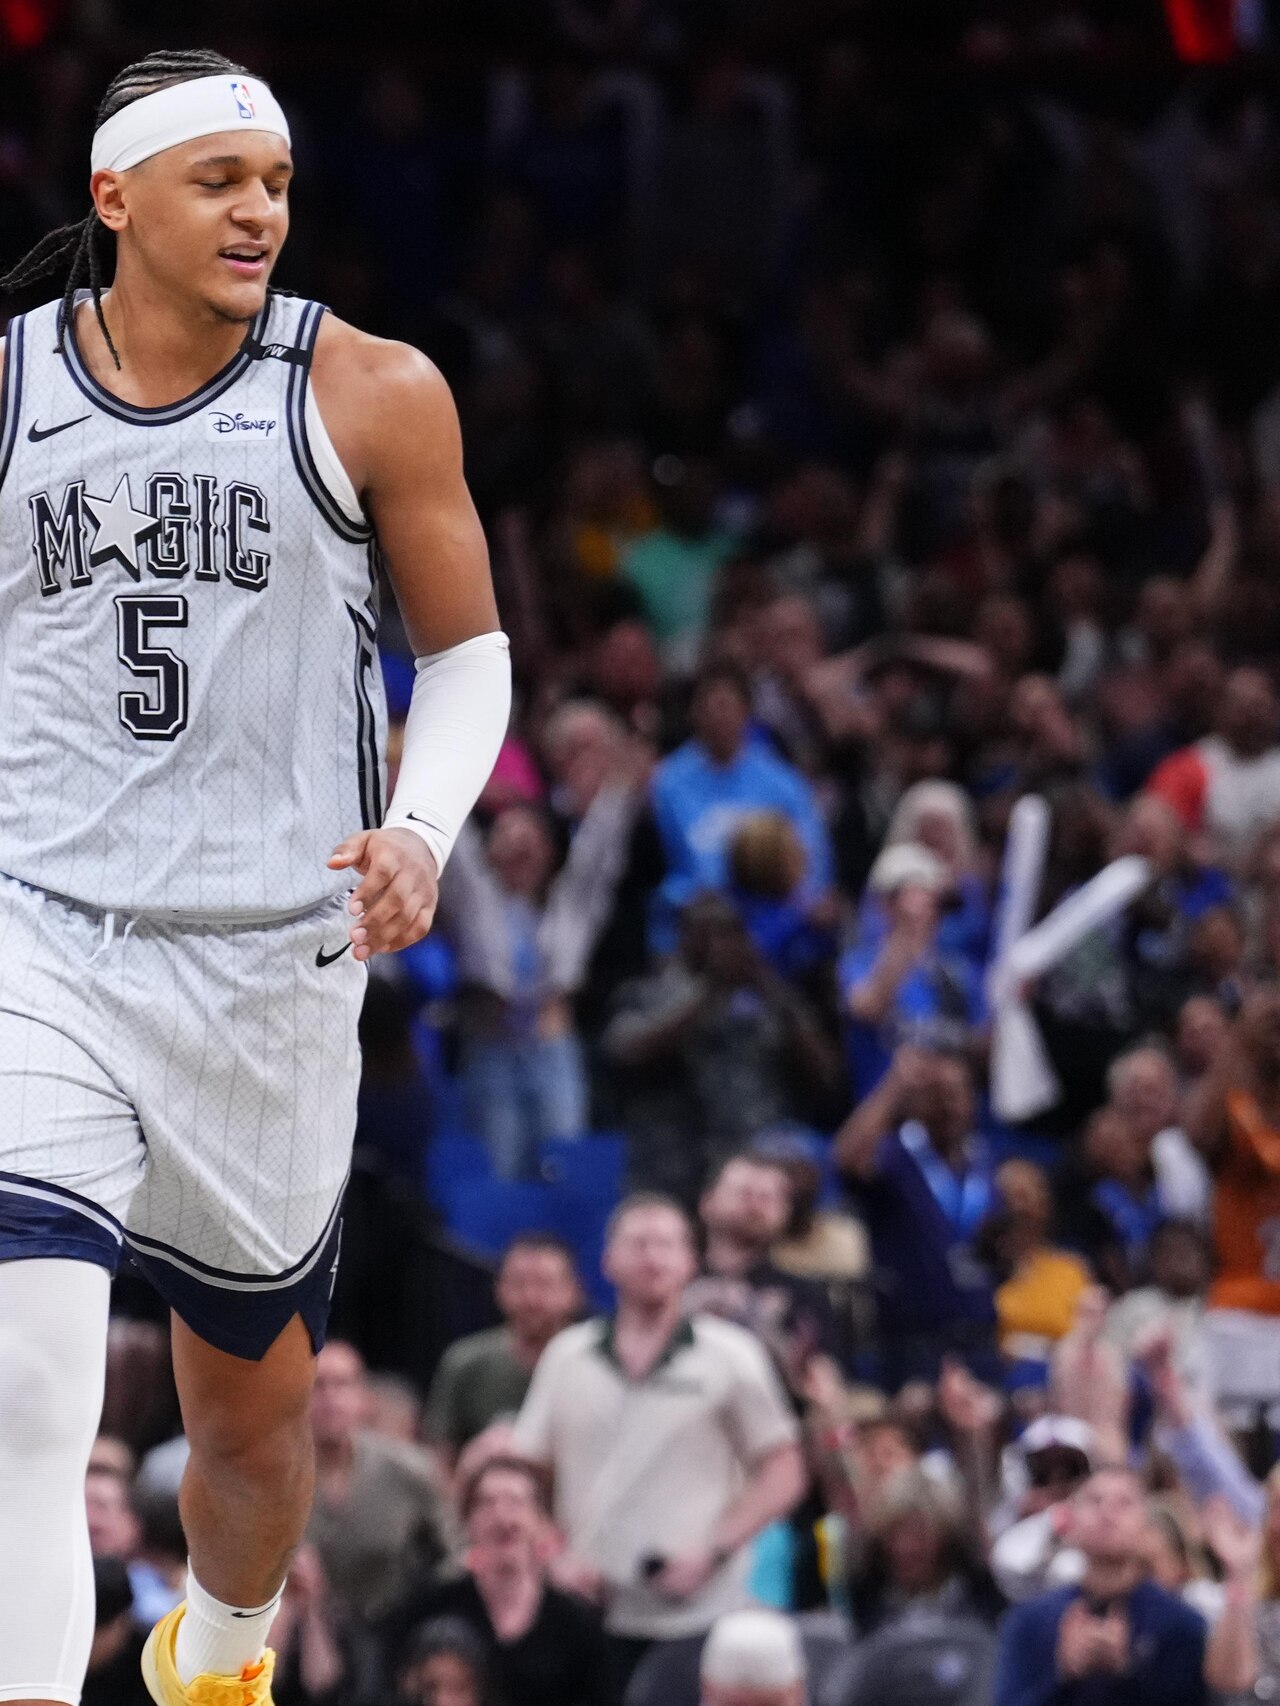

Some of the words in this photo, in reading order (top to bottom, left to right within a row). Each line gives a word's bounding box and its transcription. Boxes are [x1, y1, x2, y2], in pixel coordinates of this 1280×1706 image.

[262, 345, 288, 358] PW
[208, 411, 277, 437] Disney
[113, 594, 188, 741] 5
